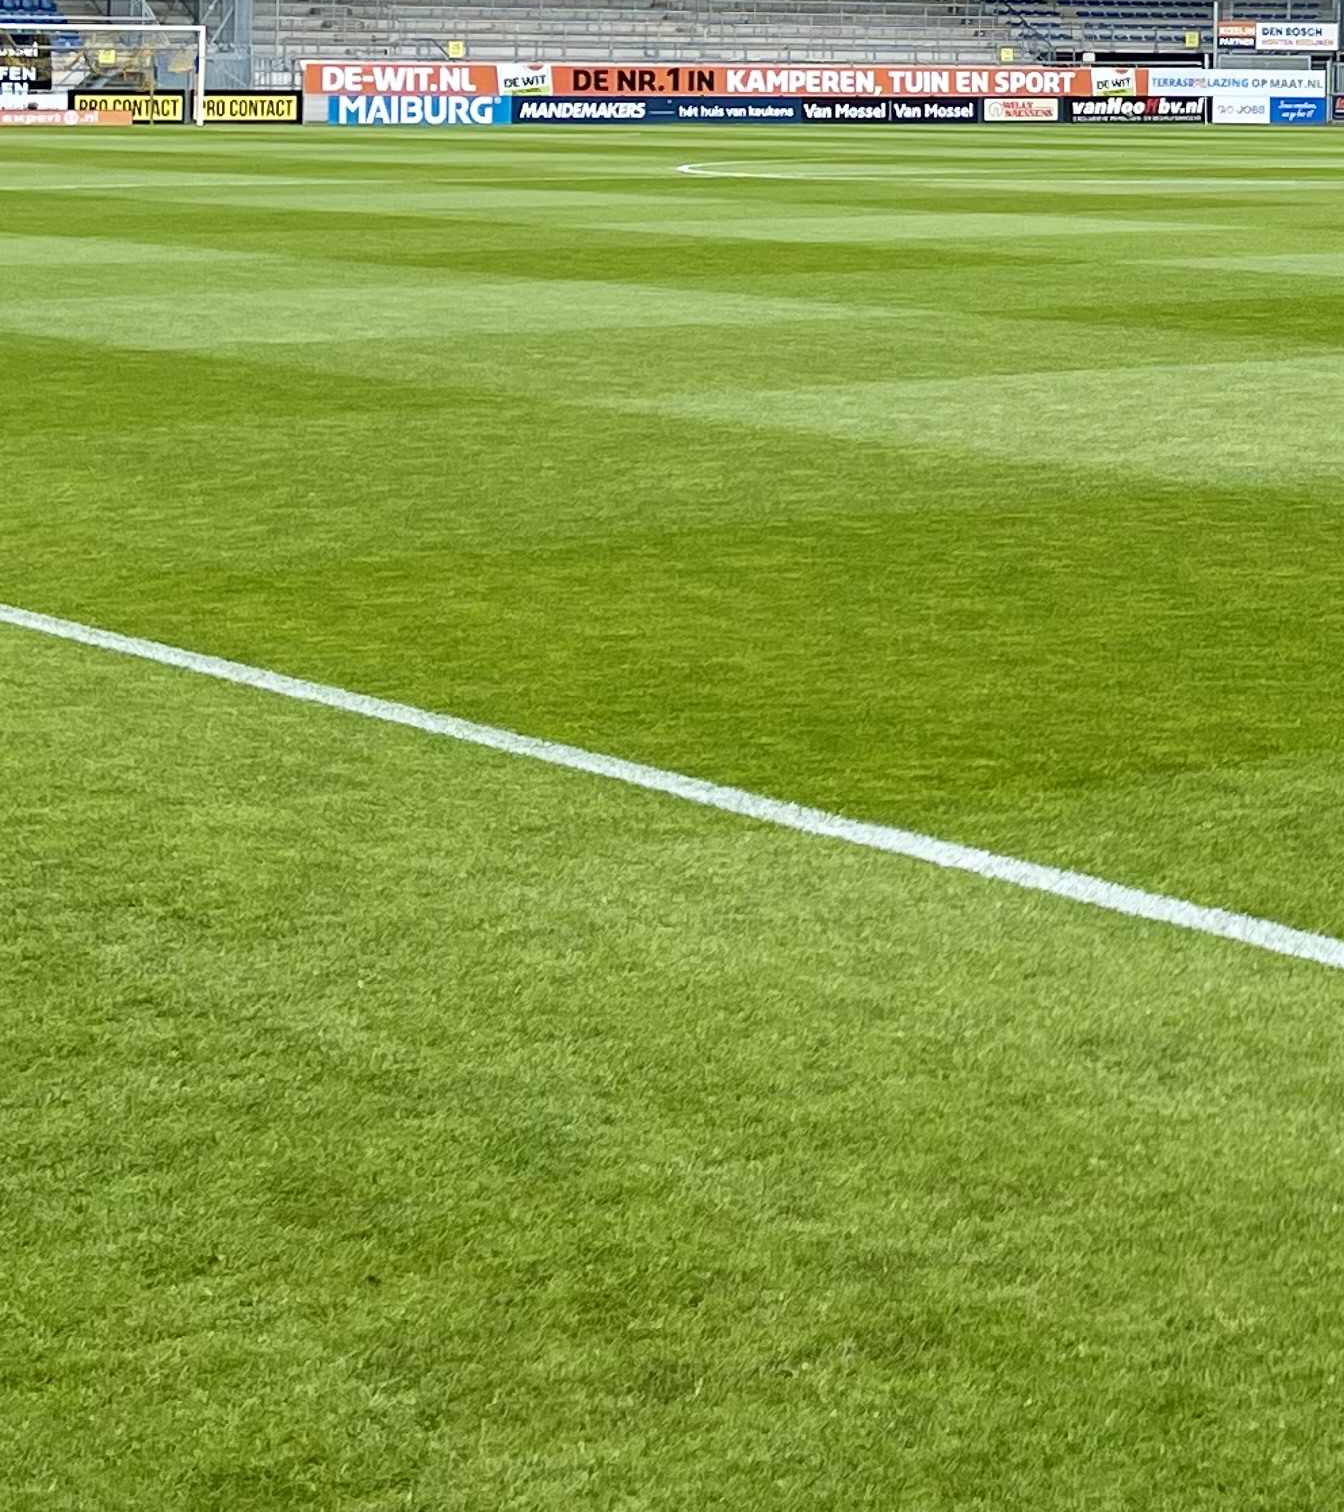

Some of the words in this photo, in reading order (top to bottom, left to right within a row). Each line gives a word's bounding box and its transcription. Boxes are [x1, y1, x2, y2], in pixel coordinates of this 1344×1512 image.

[1261, 27, 1283, 36] DEN
[321, 66, 477, 93] DE-WIT.NL
[503, 77, 520, 88] DE
[522, 74, 546, 87] WIT
[573, 70, 609, 92] DE
[616, 67, 681, 92] NR.1
[688, 70, 715, 92] IN
[725, 69, 882, 96] KAMPEREN,
[888, 70, 950, 93] TUIN
[956, 72, 991, 93] EN
[995, 71, 1076, 94] SPORT
[229, 99, 293, 117] CONTACT
[338, 96, 494, 125] MAIBURG
[519, 102, 647, 119] MANDEMAKERS
[700, 105, 725, 117] huis
[725, 108, 747, 118] van
[803, 103, 832, 119] Van
[834, 103, 887, 120] Mossel
[893, 104, 922, 119] Van
[924, 103, 974, 120] Mossel
